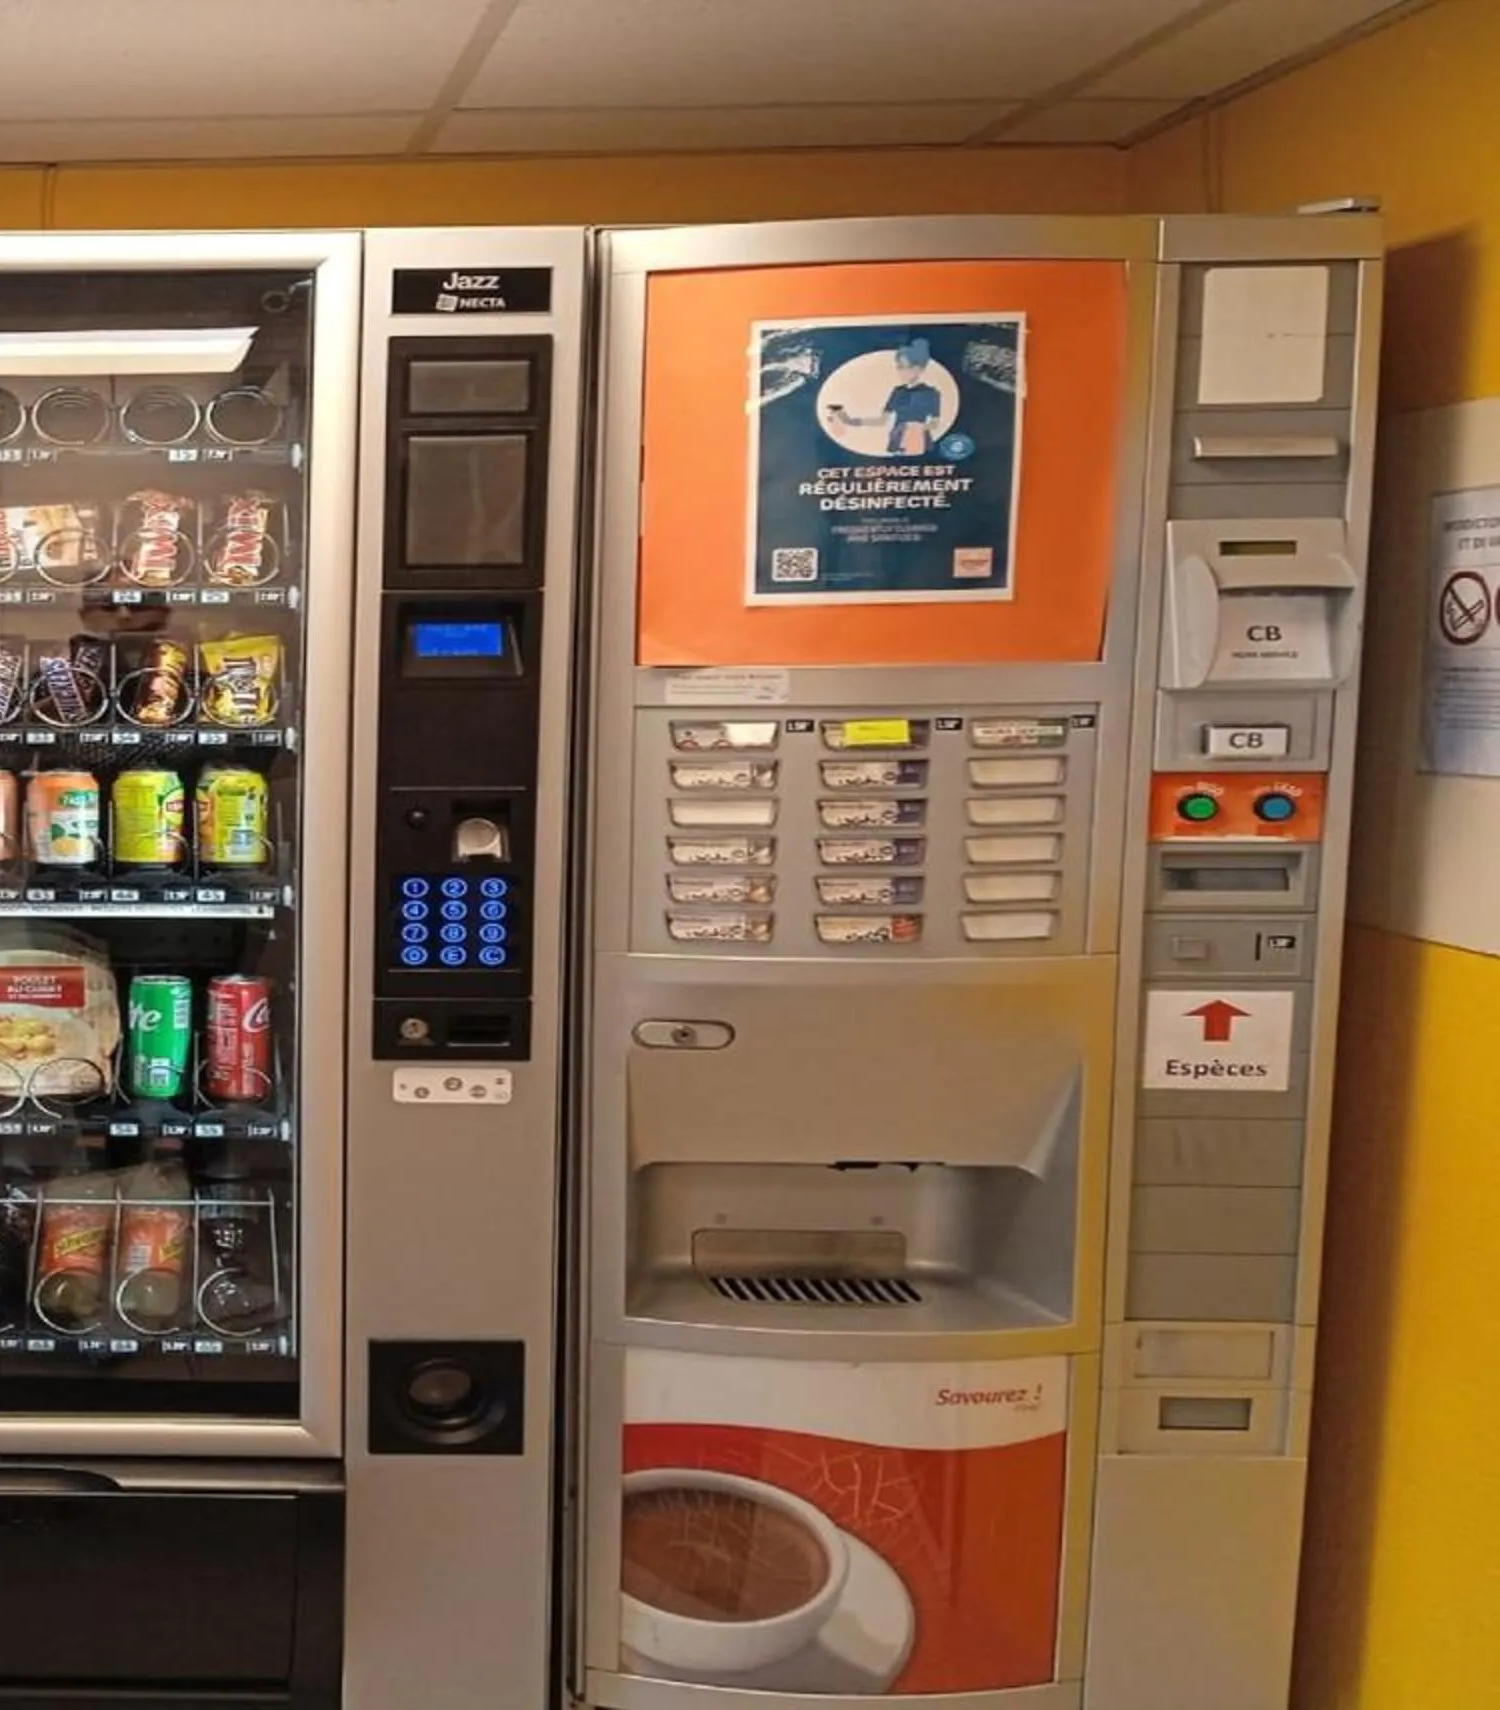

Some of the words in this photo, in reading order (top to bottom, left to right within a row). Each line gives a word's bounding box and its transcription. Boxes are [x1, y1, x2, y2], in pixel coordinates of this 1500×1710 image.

[443, 271, 500, 290] Jazz
[460, 297, 506, 309] NECTA
[817, 467, 852, 481] CET
[855, 466, 921, 480] ESPACE
[923, 464, 956, 478] EST
[799, 477, 974, 497] RÉGULIÈREMENT
[1246, 625, 1282, 642] CB
[1229, 732, 1264, 749] CB
[1165, 1059, 1268, 1080] Espèces
[935, 1388, 1029, 1405] Savourez
